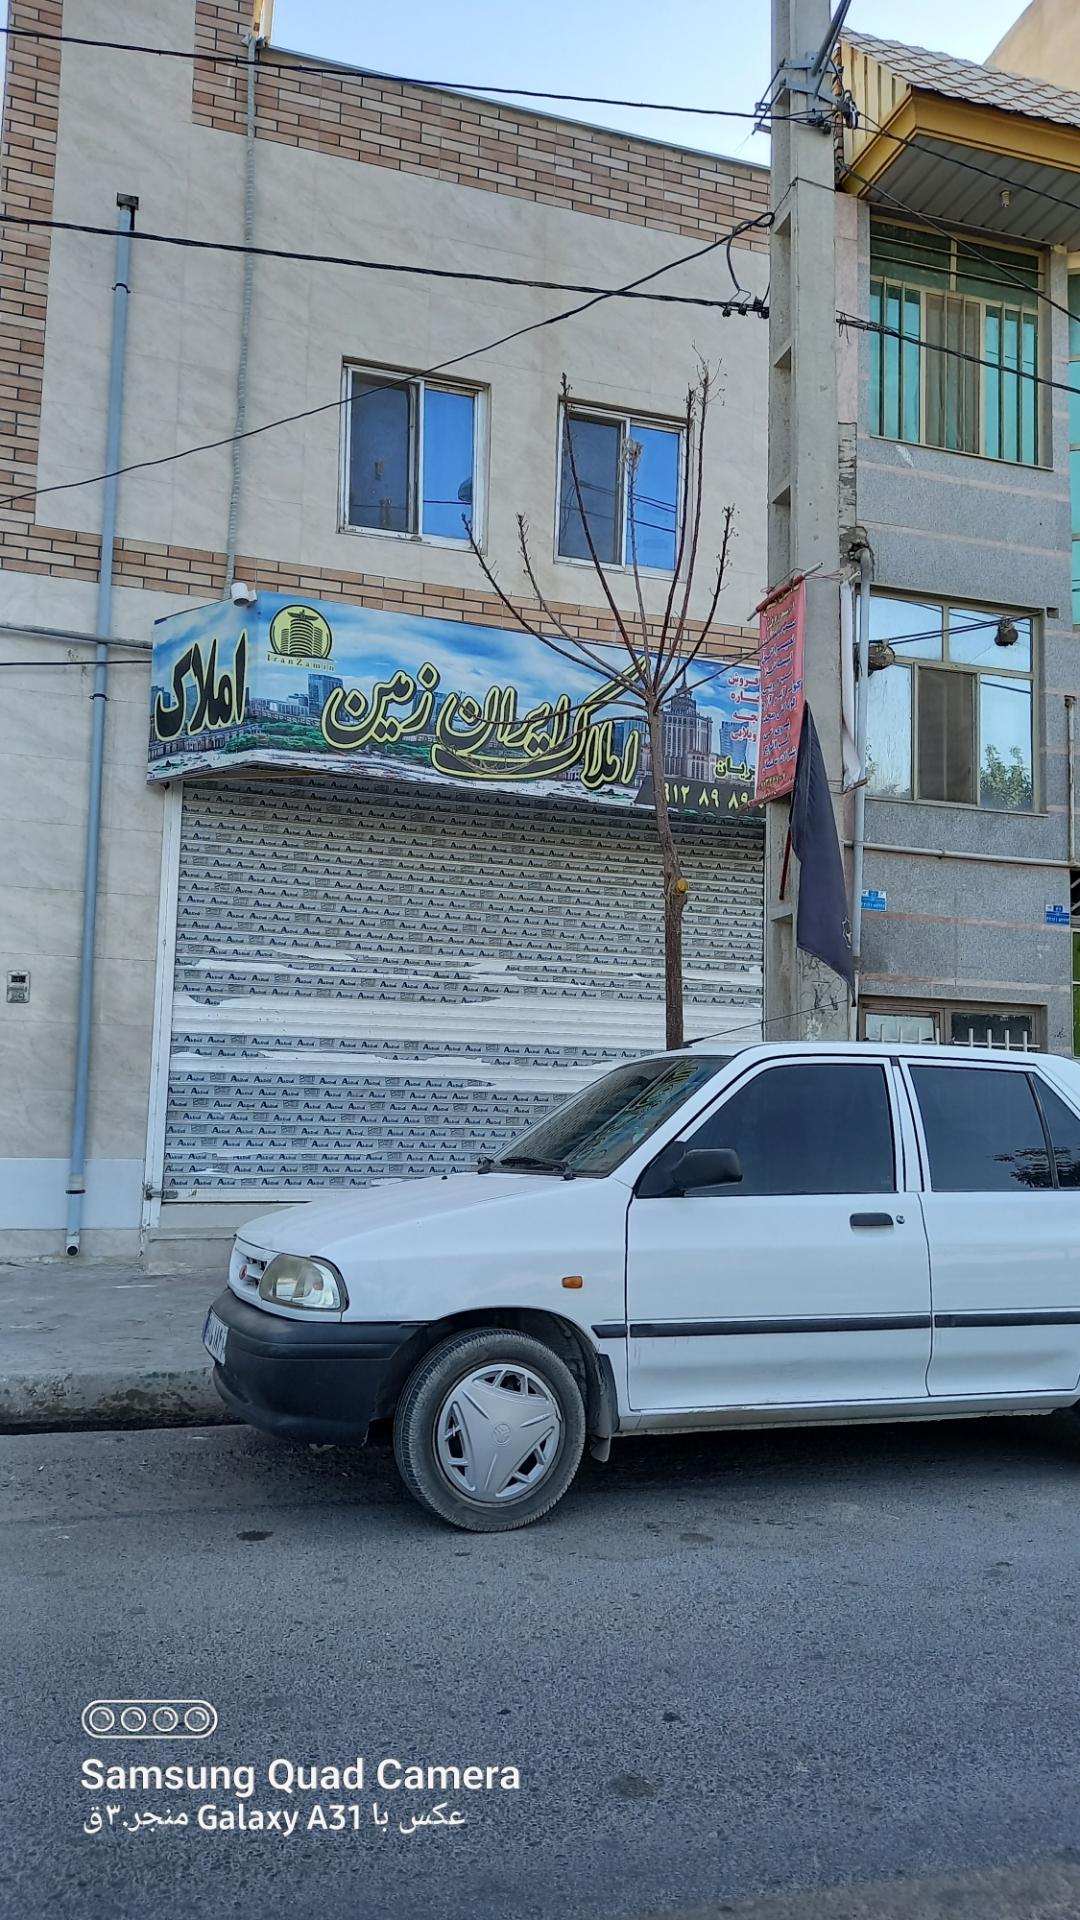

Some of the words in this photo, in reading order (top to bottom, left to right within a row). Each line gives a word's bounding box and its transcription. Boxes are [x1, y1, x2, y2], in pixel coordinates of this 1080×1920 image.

[155, 629, 247, 742] املاک
[266, 652, 336, 673] IranZamin
[321, 661, 441, 750] زمین
[431, 655, 650, 790] املاک
[436, 685, 571, 756] ایران
[698, 787, 720, 809] ۸۹
[714, 755, 756, 782] ریان
